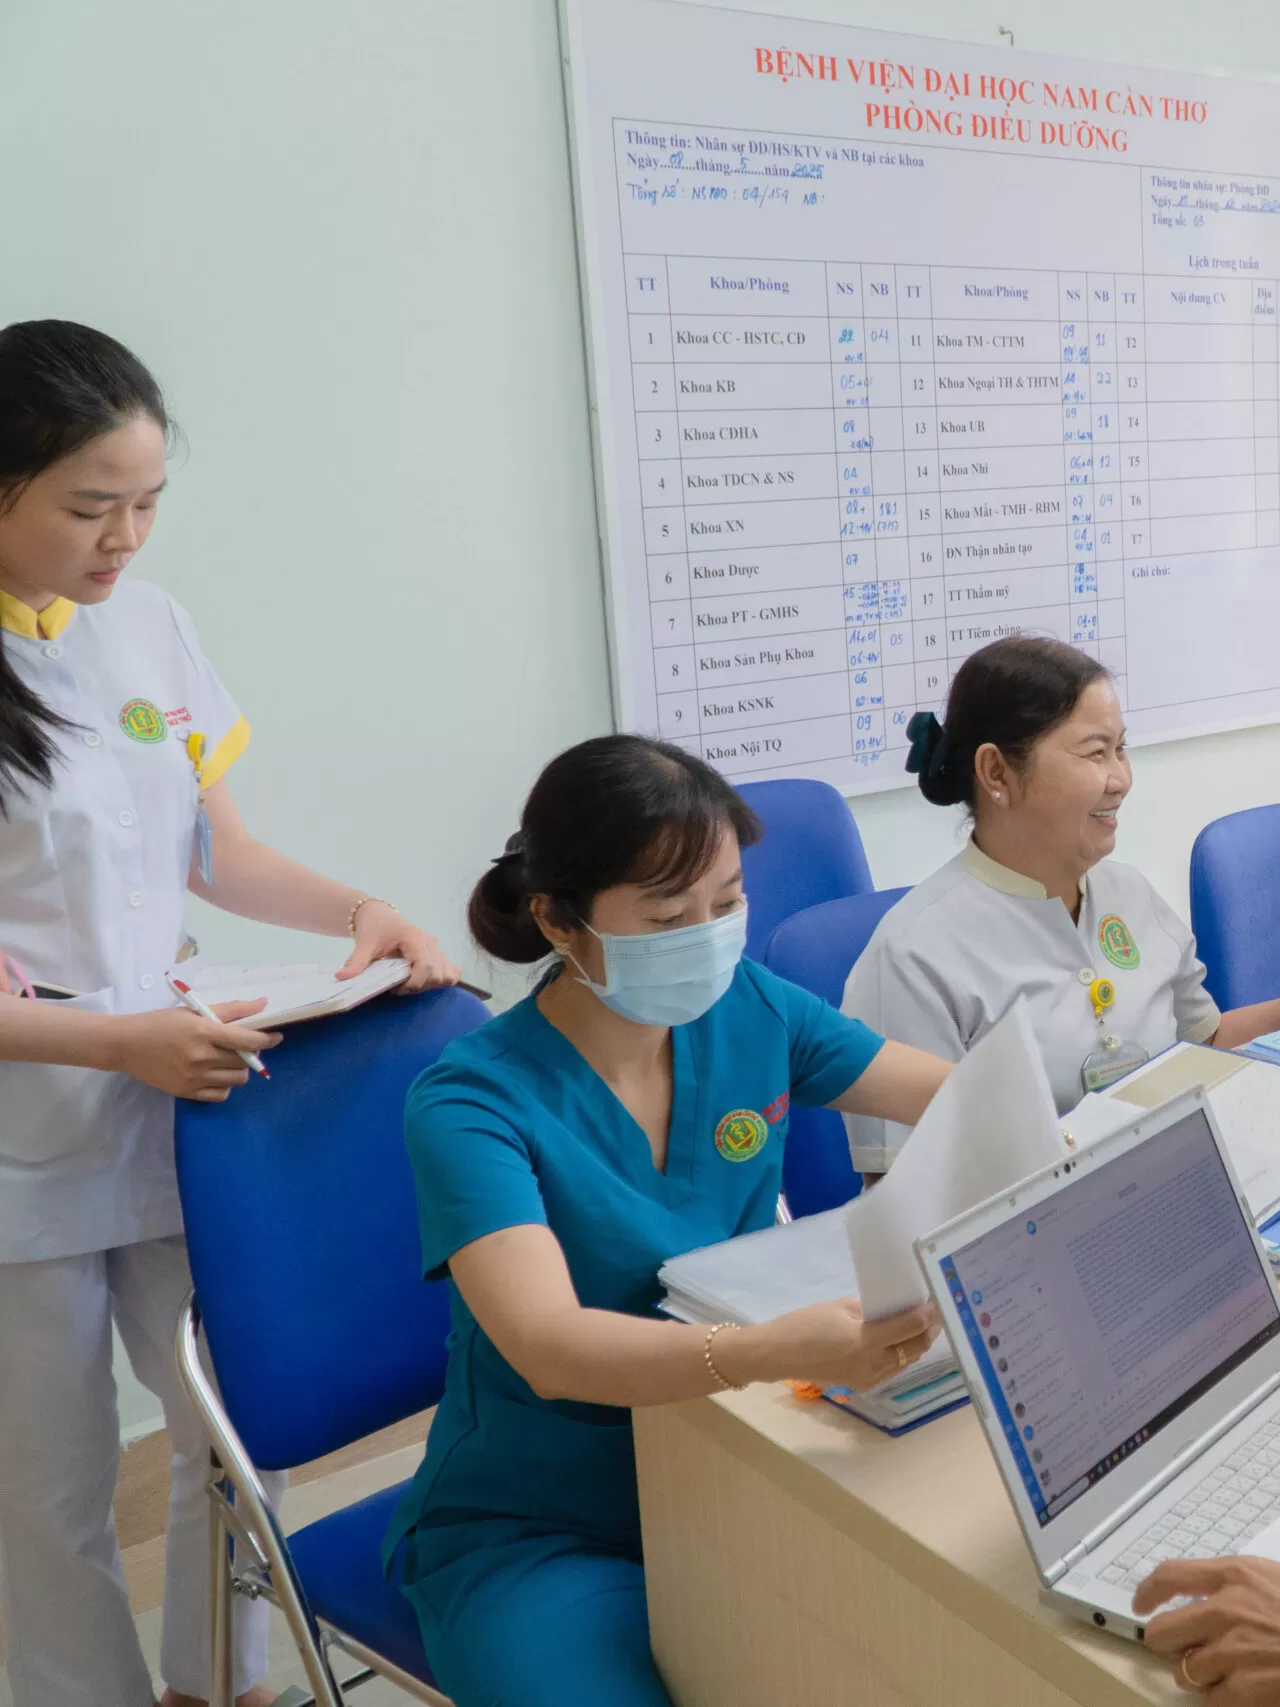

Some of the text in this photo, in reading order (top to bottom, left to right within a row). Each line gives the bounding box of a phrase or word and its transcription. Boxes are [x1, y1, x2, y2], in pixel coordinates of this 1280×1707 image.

[755, 46, 840, 83] BỆNH
[847, 58, 915, 94] VIỆN
[923, 67, 970, 101] ĐẠI
[979, 74, 1035, 107] HỌC
[1043, 82, 1098, 112] NAM
[1159, 96, 1208, 124] THƠ
[864, 99, 1128, 152] PHÒNG ĐIỀU DƯỠNG
[625, 130, 666, 150] Thông
[670, 134, 691, 149] tin:
[695, 135, 728, 151] Nhân
[825, 148, 838, 161] và
[842, 148, 859, 162] NB
[862, 152, 877, 167] tại
[879, 153, 896, 165] các
[899, 153, 925, 168] khoa
[627, 152, 660, 171] Ngày
[1188, 254, 1237, 271] Lịch trong
[636, 276, 658, 292] TT
[709, 276, 790, 294] Khoa/Phòng
[836, 282, 855, 295] NS
[870, 282, 889, 297] NB
[904, 285, 923, 299] TT
[963, 283, 1029, 301] Khoa/Phòng
[1065, 290, 1082, 301] NS
[1094, 291, 1110, 303] NB
[1122, 292, 1138, 304] TT
[646, 331, 655, 345] 1
[676, 330, 709, 345] Khoa
[712, 331, 733, 345] CC
[743, 331, 785, 347] HSTC,
[911, 334, 921, 347] 11
[936, 335, 963, 348] Khoa
[965, 335, 984, 348] TM
[651, 380, 659, 393] 2
[679, 379, 736, 394] Khoa KB
[913, 378, 925, 391] 12
[938, 376, 965, 389] Khoa
[999, 376, 1014, 389] TH
[1026, 376, 1060, 389] THTM
[683, 426, 760, 441] Khoa CĐHA
[915, 421, 927, 435] 13
[940, 420, 985, 434] Khoa UB
[654, 429, 662, 442] 3
[916, 466, 928, 478] 14
[942, 462, 989, 477] Khoa Nhi
[657, 476, 665, 490] 4
[687, 471, 796, 489] Khoa TDCN & NS
[919, 508, 931, 521] 15
[944, 507, 970, 520] Khoa
[1000, 502, 1026, 517] TMH
[1035, 501, 1061, 514] RHM
[661, 524, 669, 538] 5
[690, 519, 745, 536] Khoa XN
[920, 551, 933, 564] 16
[664, 571, 673, 585] 6
[693, 563, 760, 581] Khoa Dược
[922, 592, 935, 606] 17
[948, 588, 963, 602] TT
[696, 604, 800, 628] Khoa PT GMHS
[668, 617, 676, 631] 7
[925, 634, 937, 647] 18
[950, 629, 965, 642] TT
[700, 656, 732, 672] Khoa
[758, 651, 782, 665] Phụ
[784, 647, 815, 662] Khoa
[671, 664, 680, 677] 8
[926, 675, 938, 689] 19
[703, 696, 775, 718] Khoa KSNK
[675, 709, 682, 723] 9
[706, 737, 783, 761] Khoa Nội TQ
